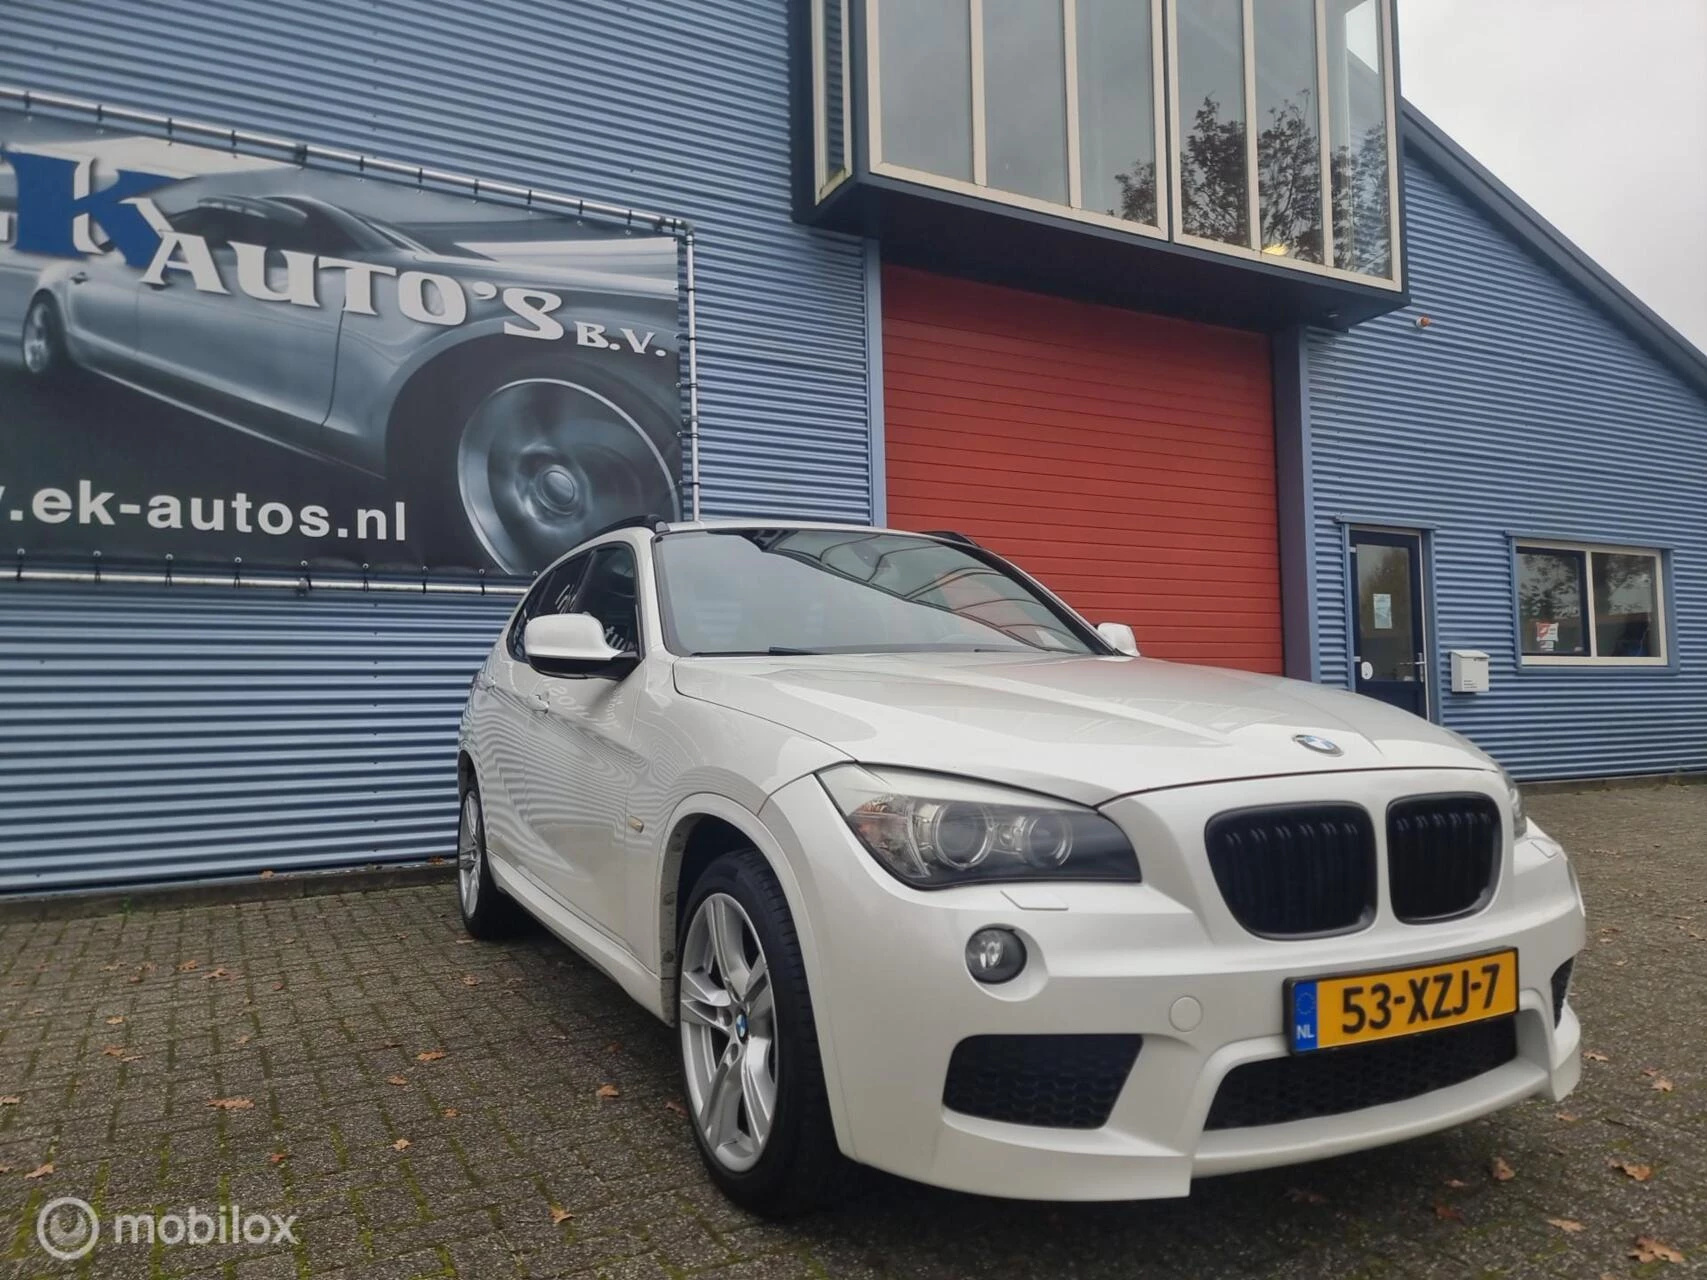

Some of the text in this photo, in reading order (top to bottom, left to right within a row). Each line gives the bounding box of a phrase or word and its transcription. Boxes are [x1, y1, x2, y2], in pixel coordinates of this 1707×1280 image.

[0, 149, 667, 357] K AUTO'S B.V.
[1296, 1024, 1315, 1040] NL
[1341, 963, 1500, 1034] 53-XZJ-7
